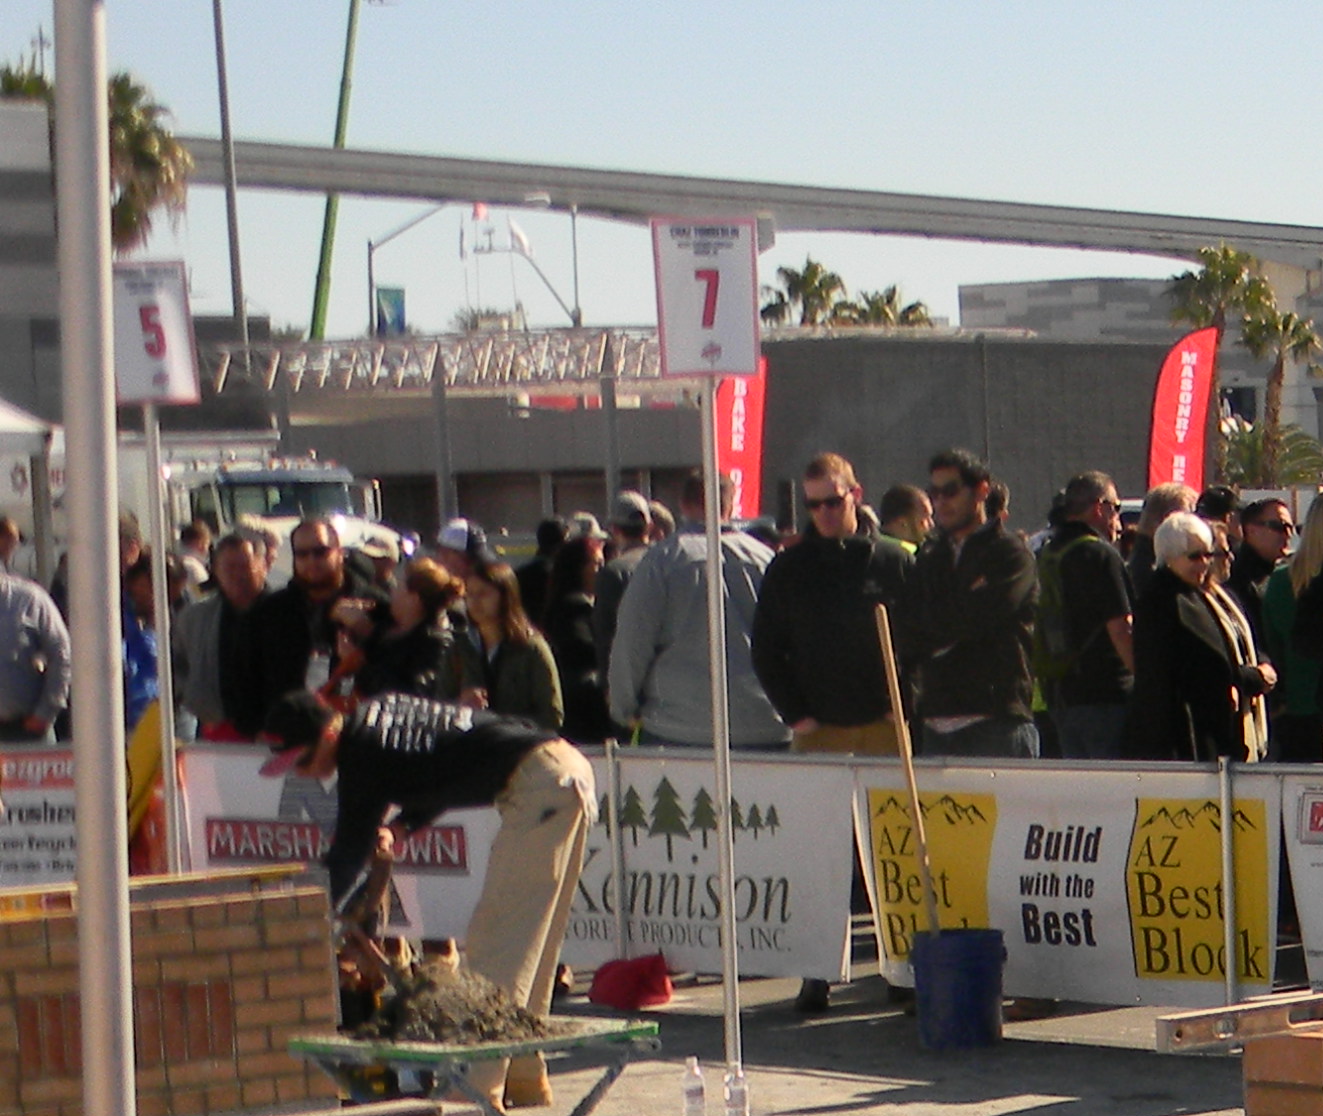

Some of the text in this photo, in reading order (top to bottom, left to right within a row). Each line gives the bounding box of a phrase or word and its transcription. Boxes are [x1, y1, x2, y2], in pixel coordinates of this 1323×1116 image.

[694, 268, 720, 329] 7
[139, 304, 167, 361] 5
[1175, 351, 1198, 443] MASONRY
[1173, 454, 1187, 484] HE
[879, 825, 914, 857] AZ
[1024, 824, 1103, 863] Build
[1135, 835, 1182, 868] AZ
[1019, 872, 1095, 899] with the
[1135, 871, 1225, 921] Best
[750, 927, 792, 952] INC.
[1021, 902, 1097, 948] Best
